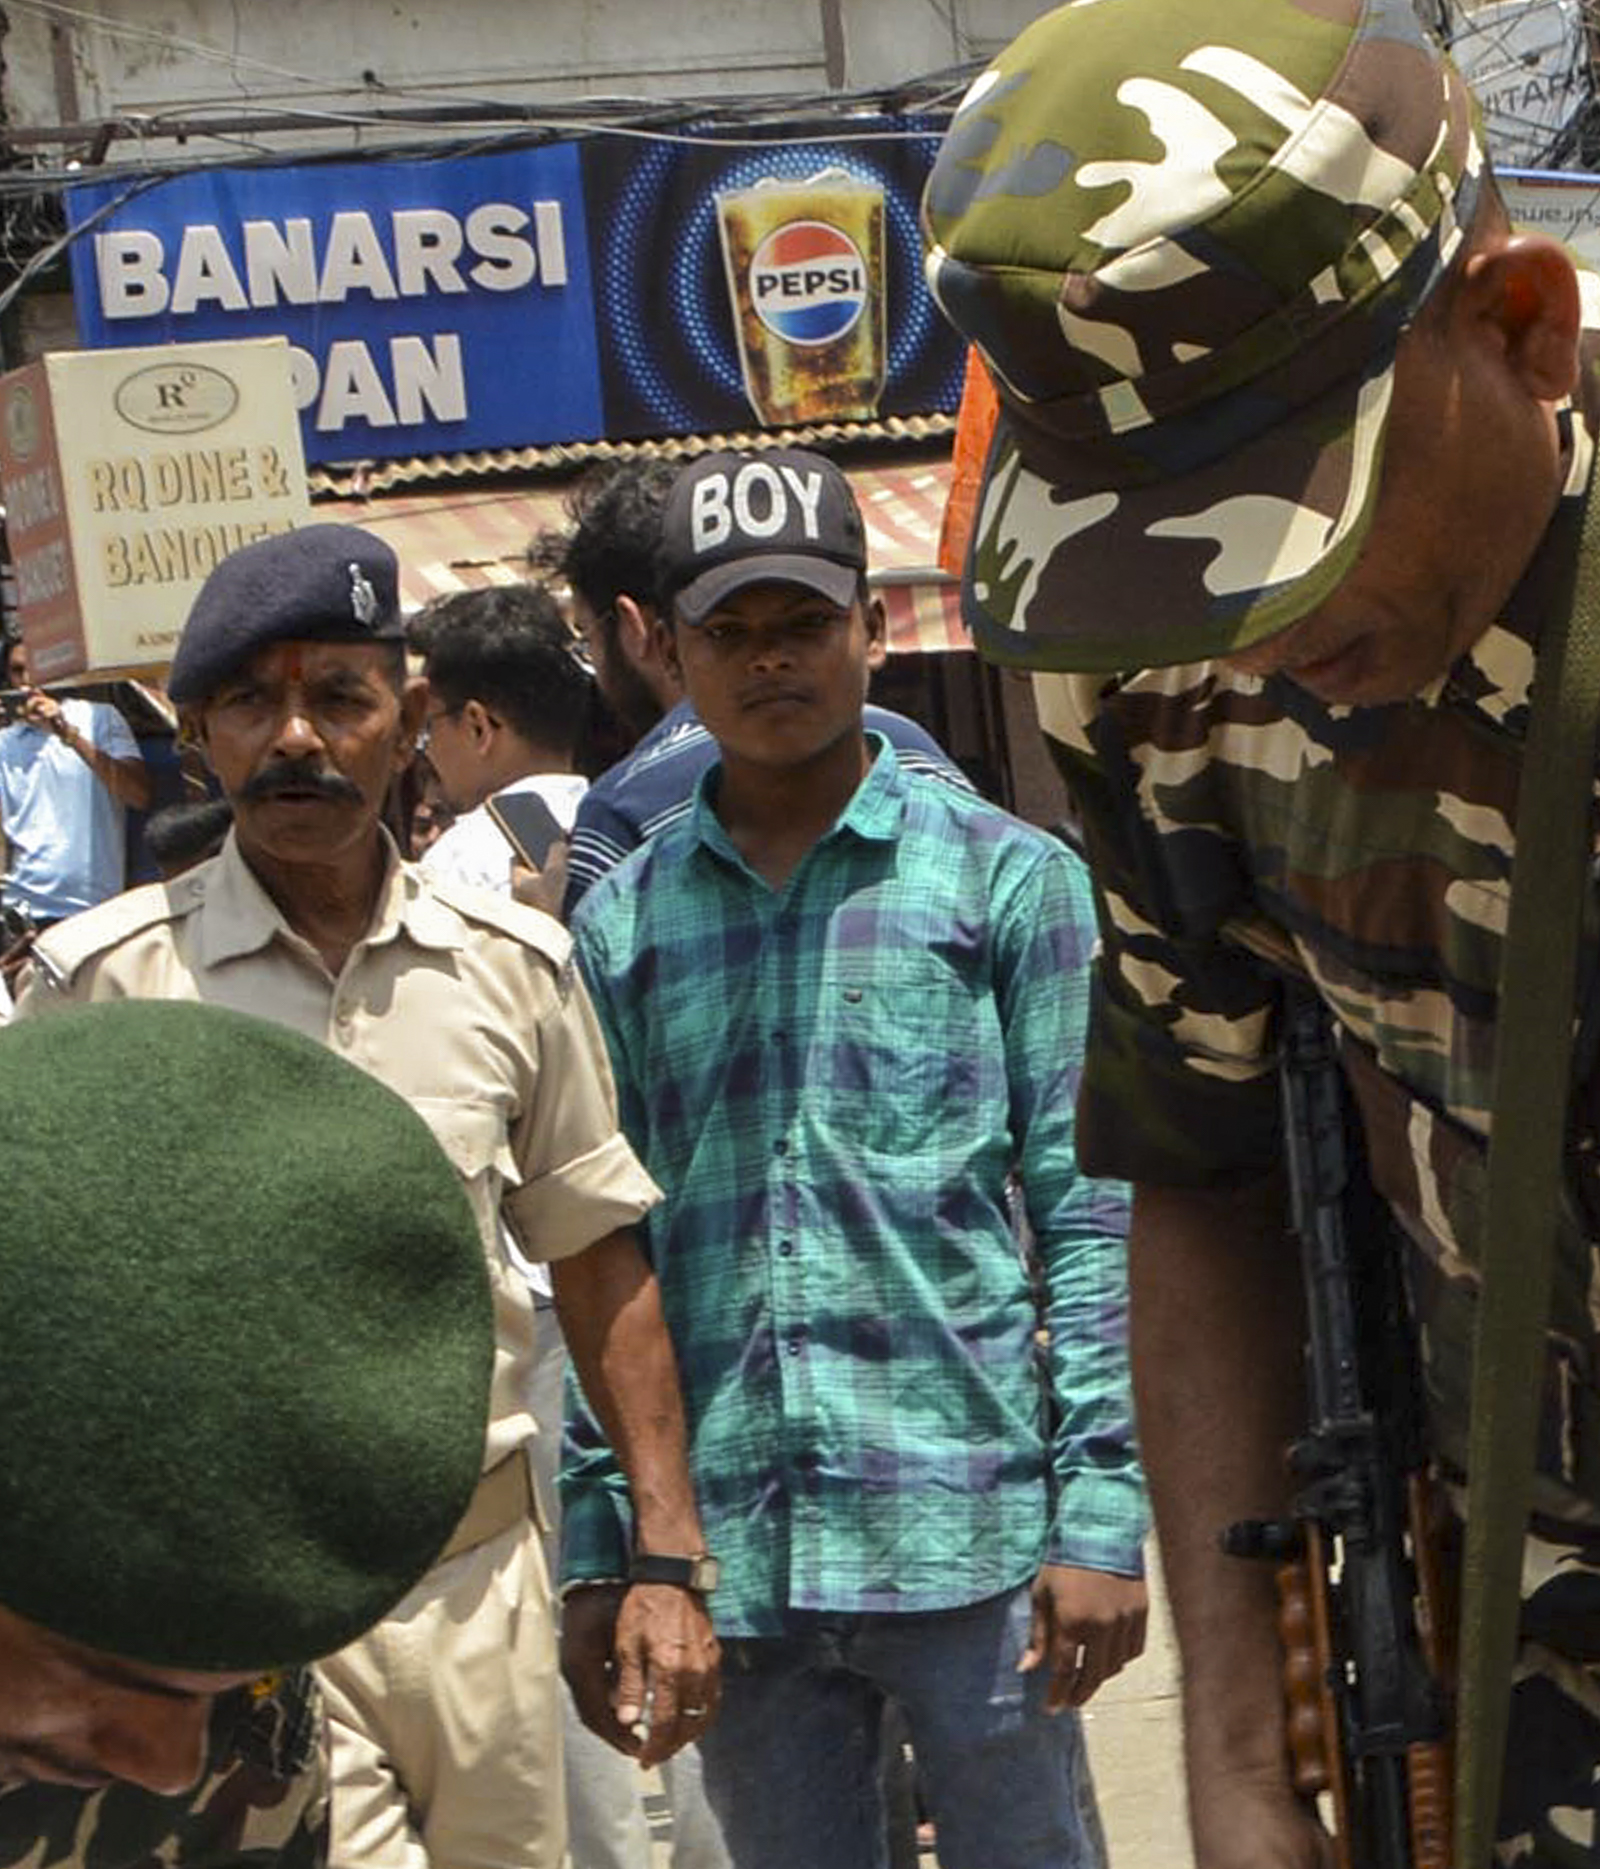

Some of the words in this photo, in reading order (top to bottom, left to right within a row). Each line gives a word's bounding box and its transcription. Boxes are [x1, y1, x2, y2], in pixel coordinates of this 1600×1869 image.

[94, 200, 568, 319] BANARSI
[755, 267, 862, 298] PEPSI
[88, 456, 149, 513] RQ
[150, 447, 253, 507] DINE
[258, 444, 292, 498] &
[692, 462, 822, 553] BOY
